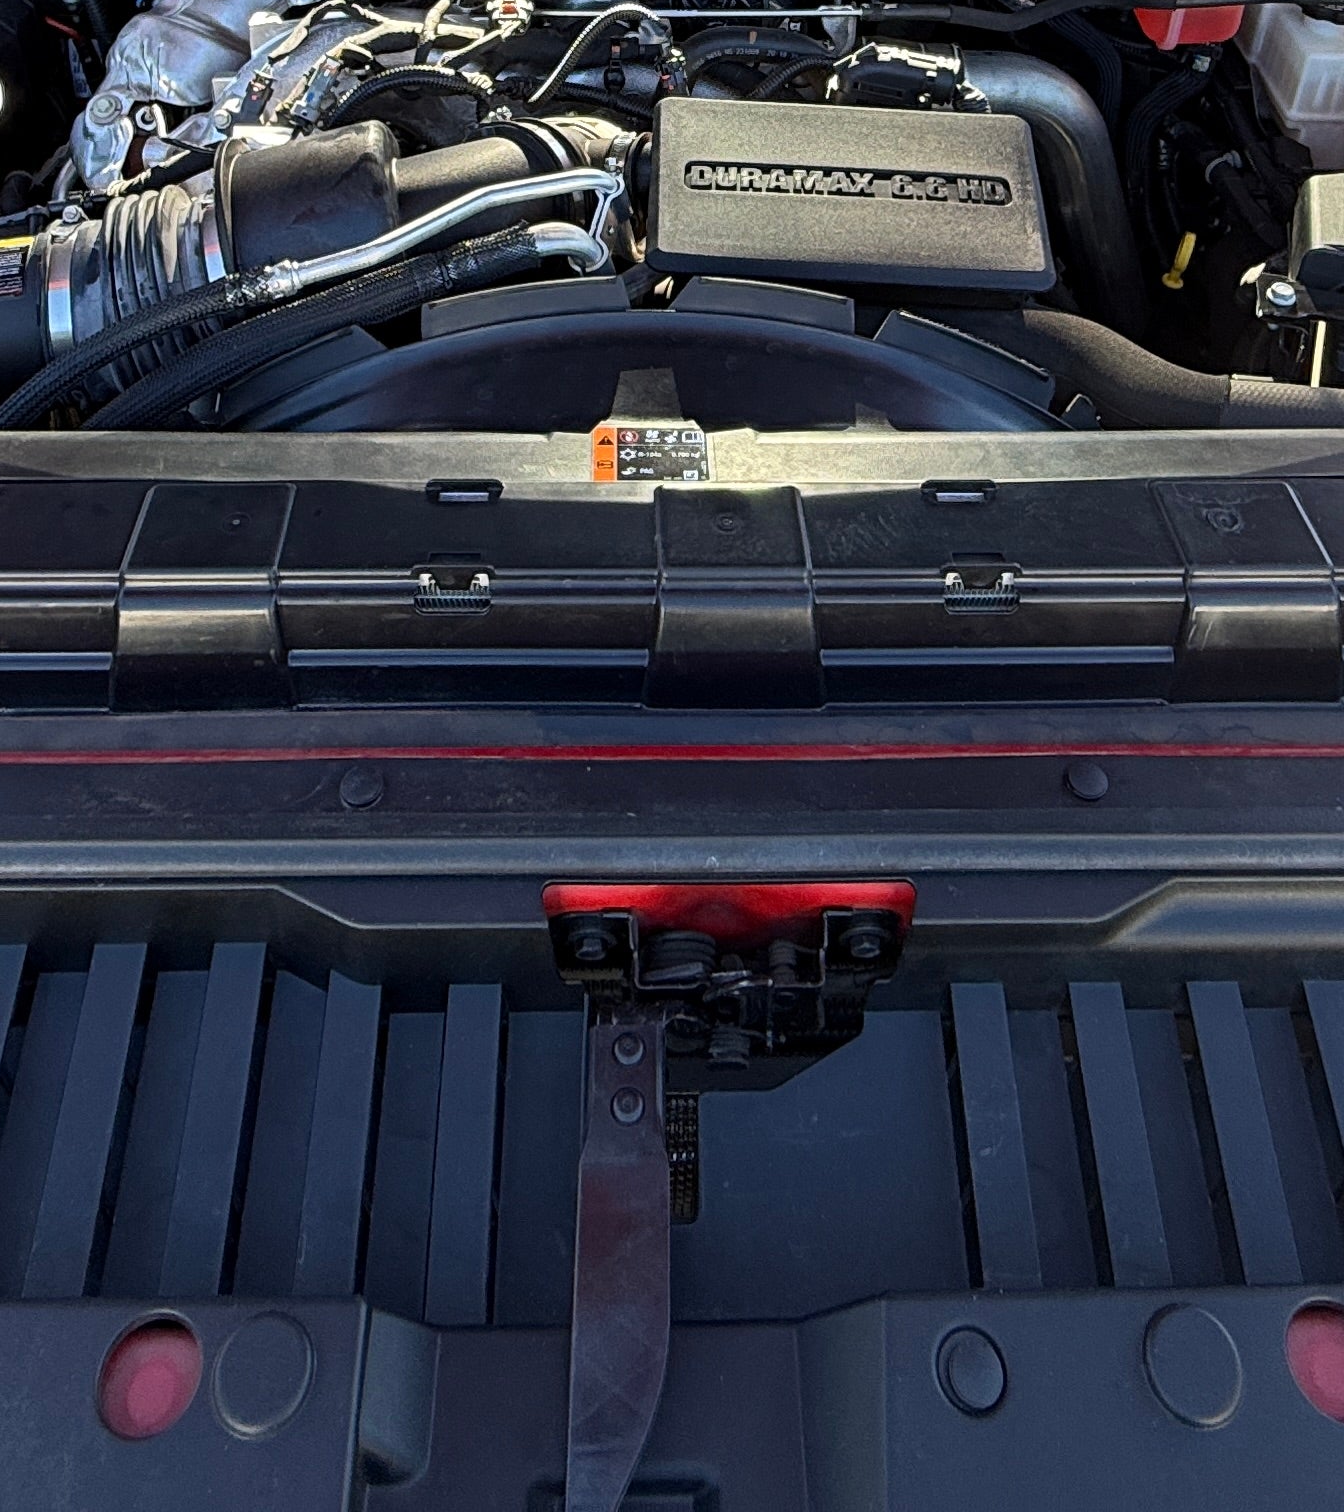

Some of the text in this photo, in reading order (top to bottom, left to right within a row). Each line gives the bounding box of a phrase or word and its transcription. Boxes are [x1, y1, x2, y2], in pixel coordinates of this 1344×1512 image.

[690, 165, 1007, 202] DURAMAX 6.6 HD
